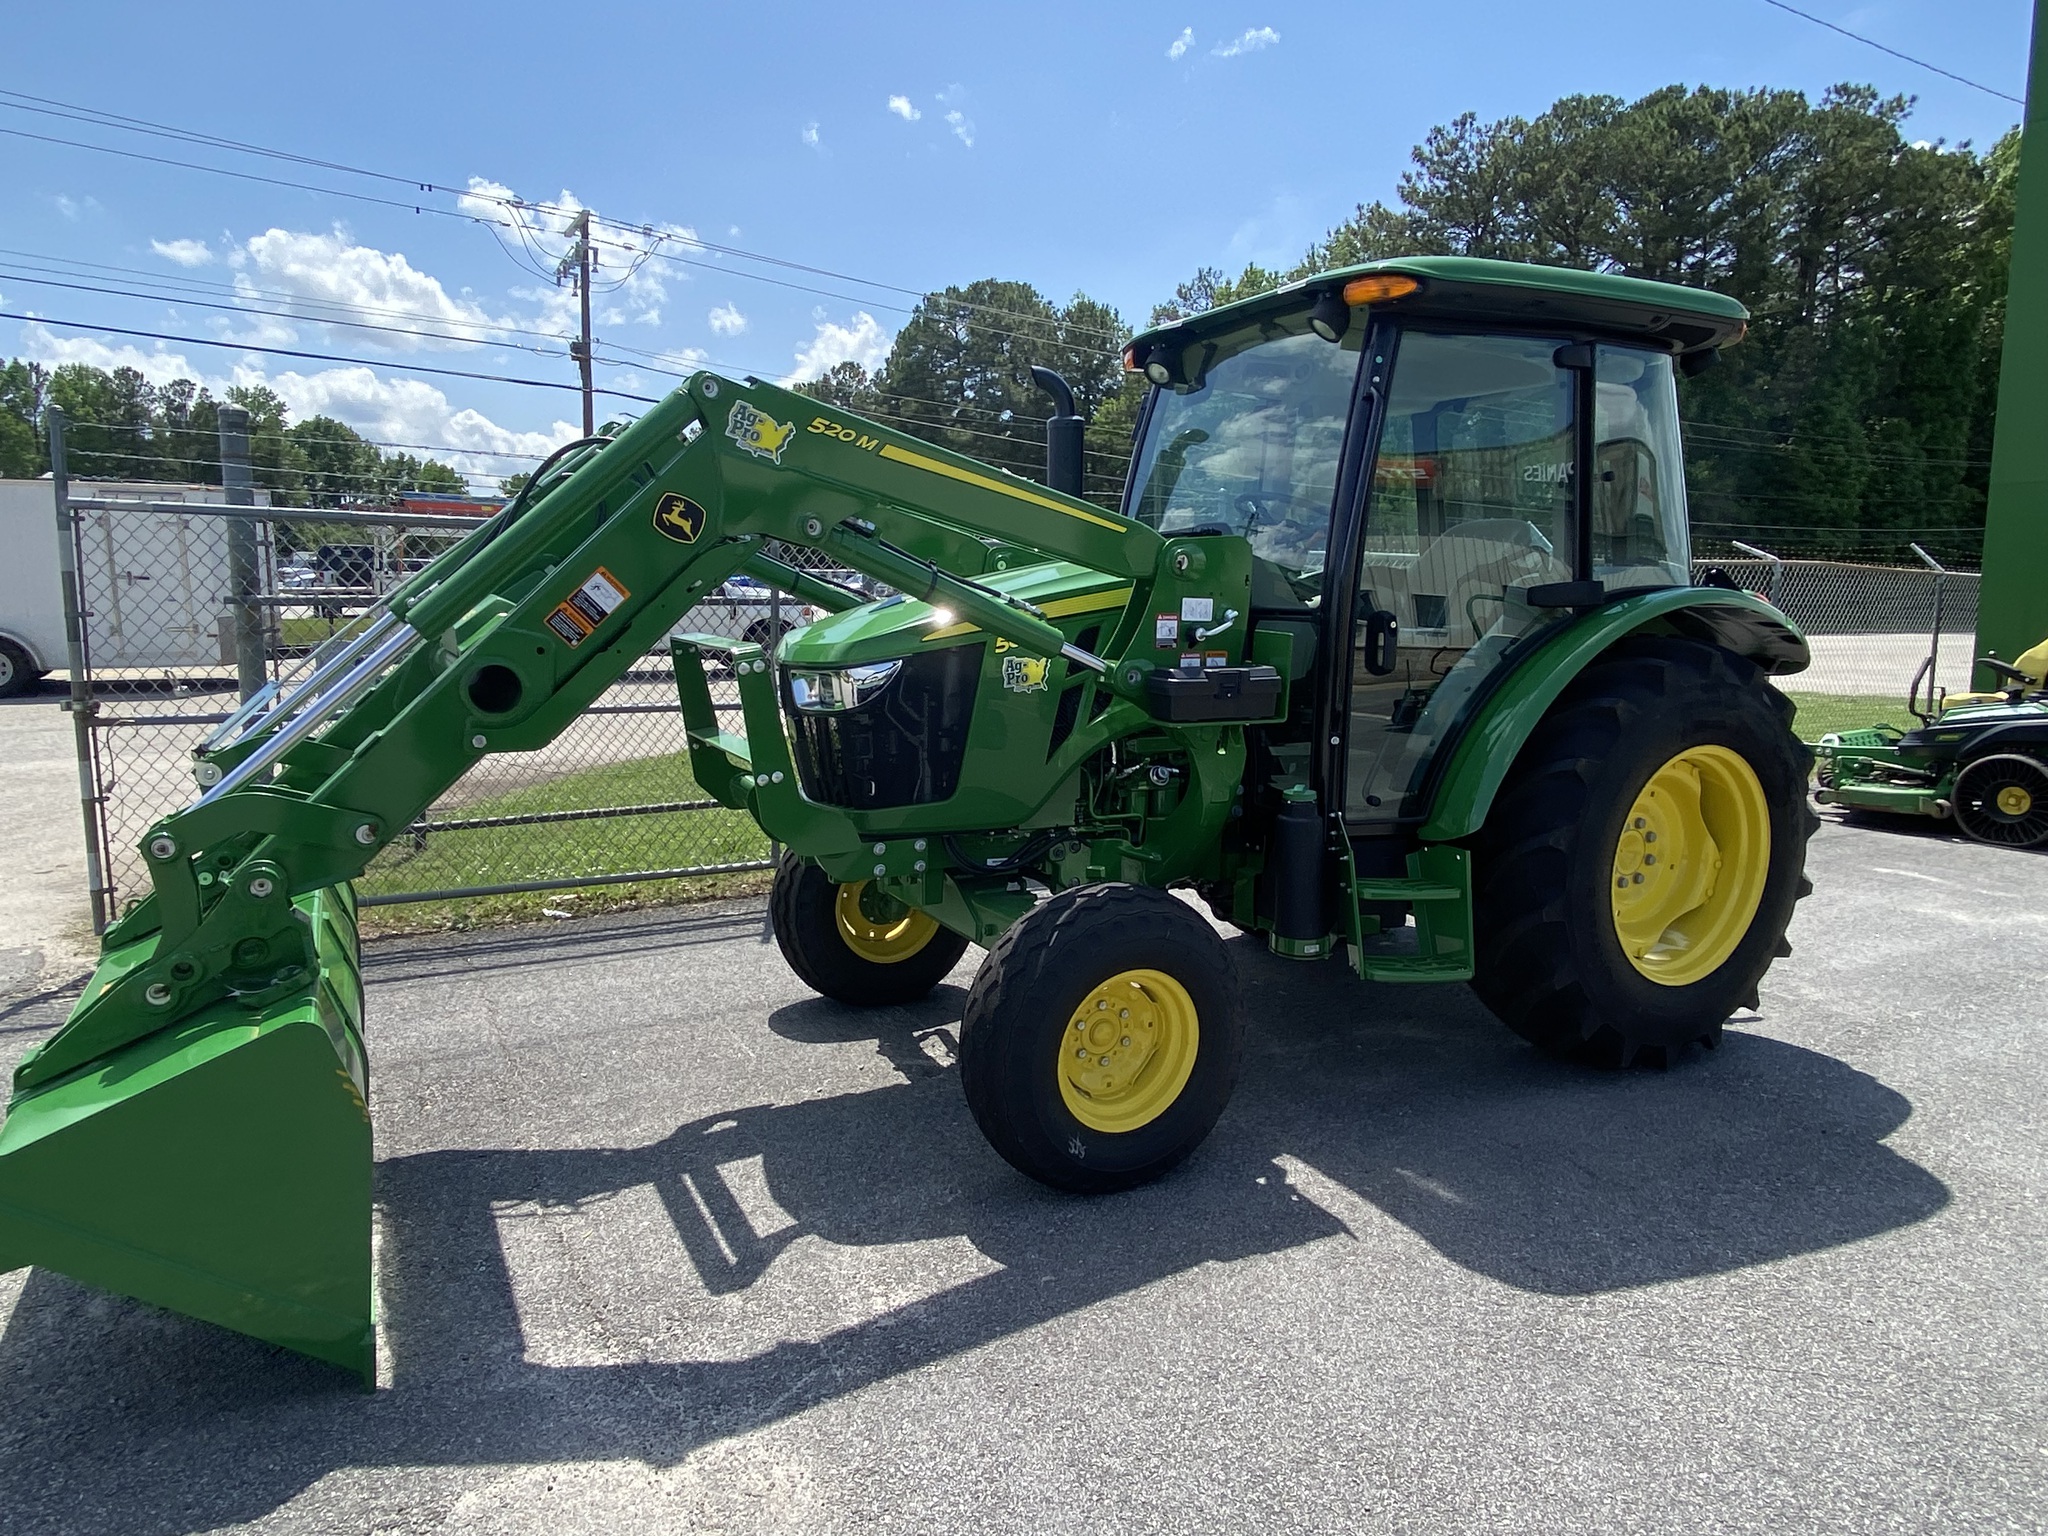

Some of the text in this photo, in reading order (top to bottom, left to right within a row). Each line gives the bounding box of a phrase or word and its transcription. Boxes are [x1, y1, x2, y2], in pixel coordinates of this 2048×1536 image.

[733, 404, 764, 427] Ag-
[729, 419, 761, 442] Pro
[995, 636, 1019, 653] 5
[1006, 659, 1027, 674] Ag-
[1007, 672, 1028, 685] Pro
